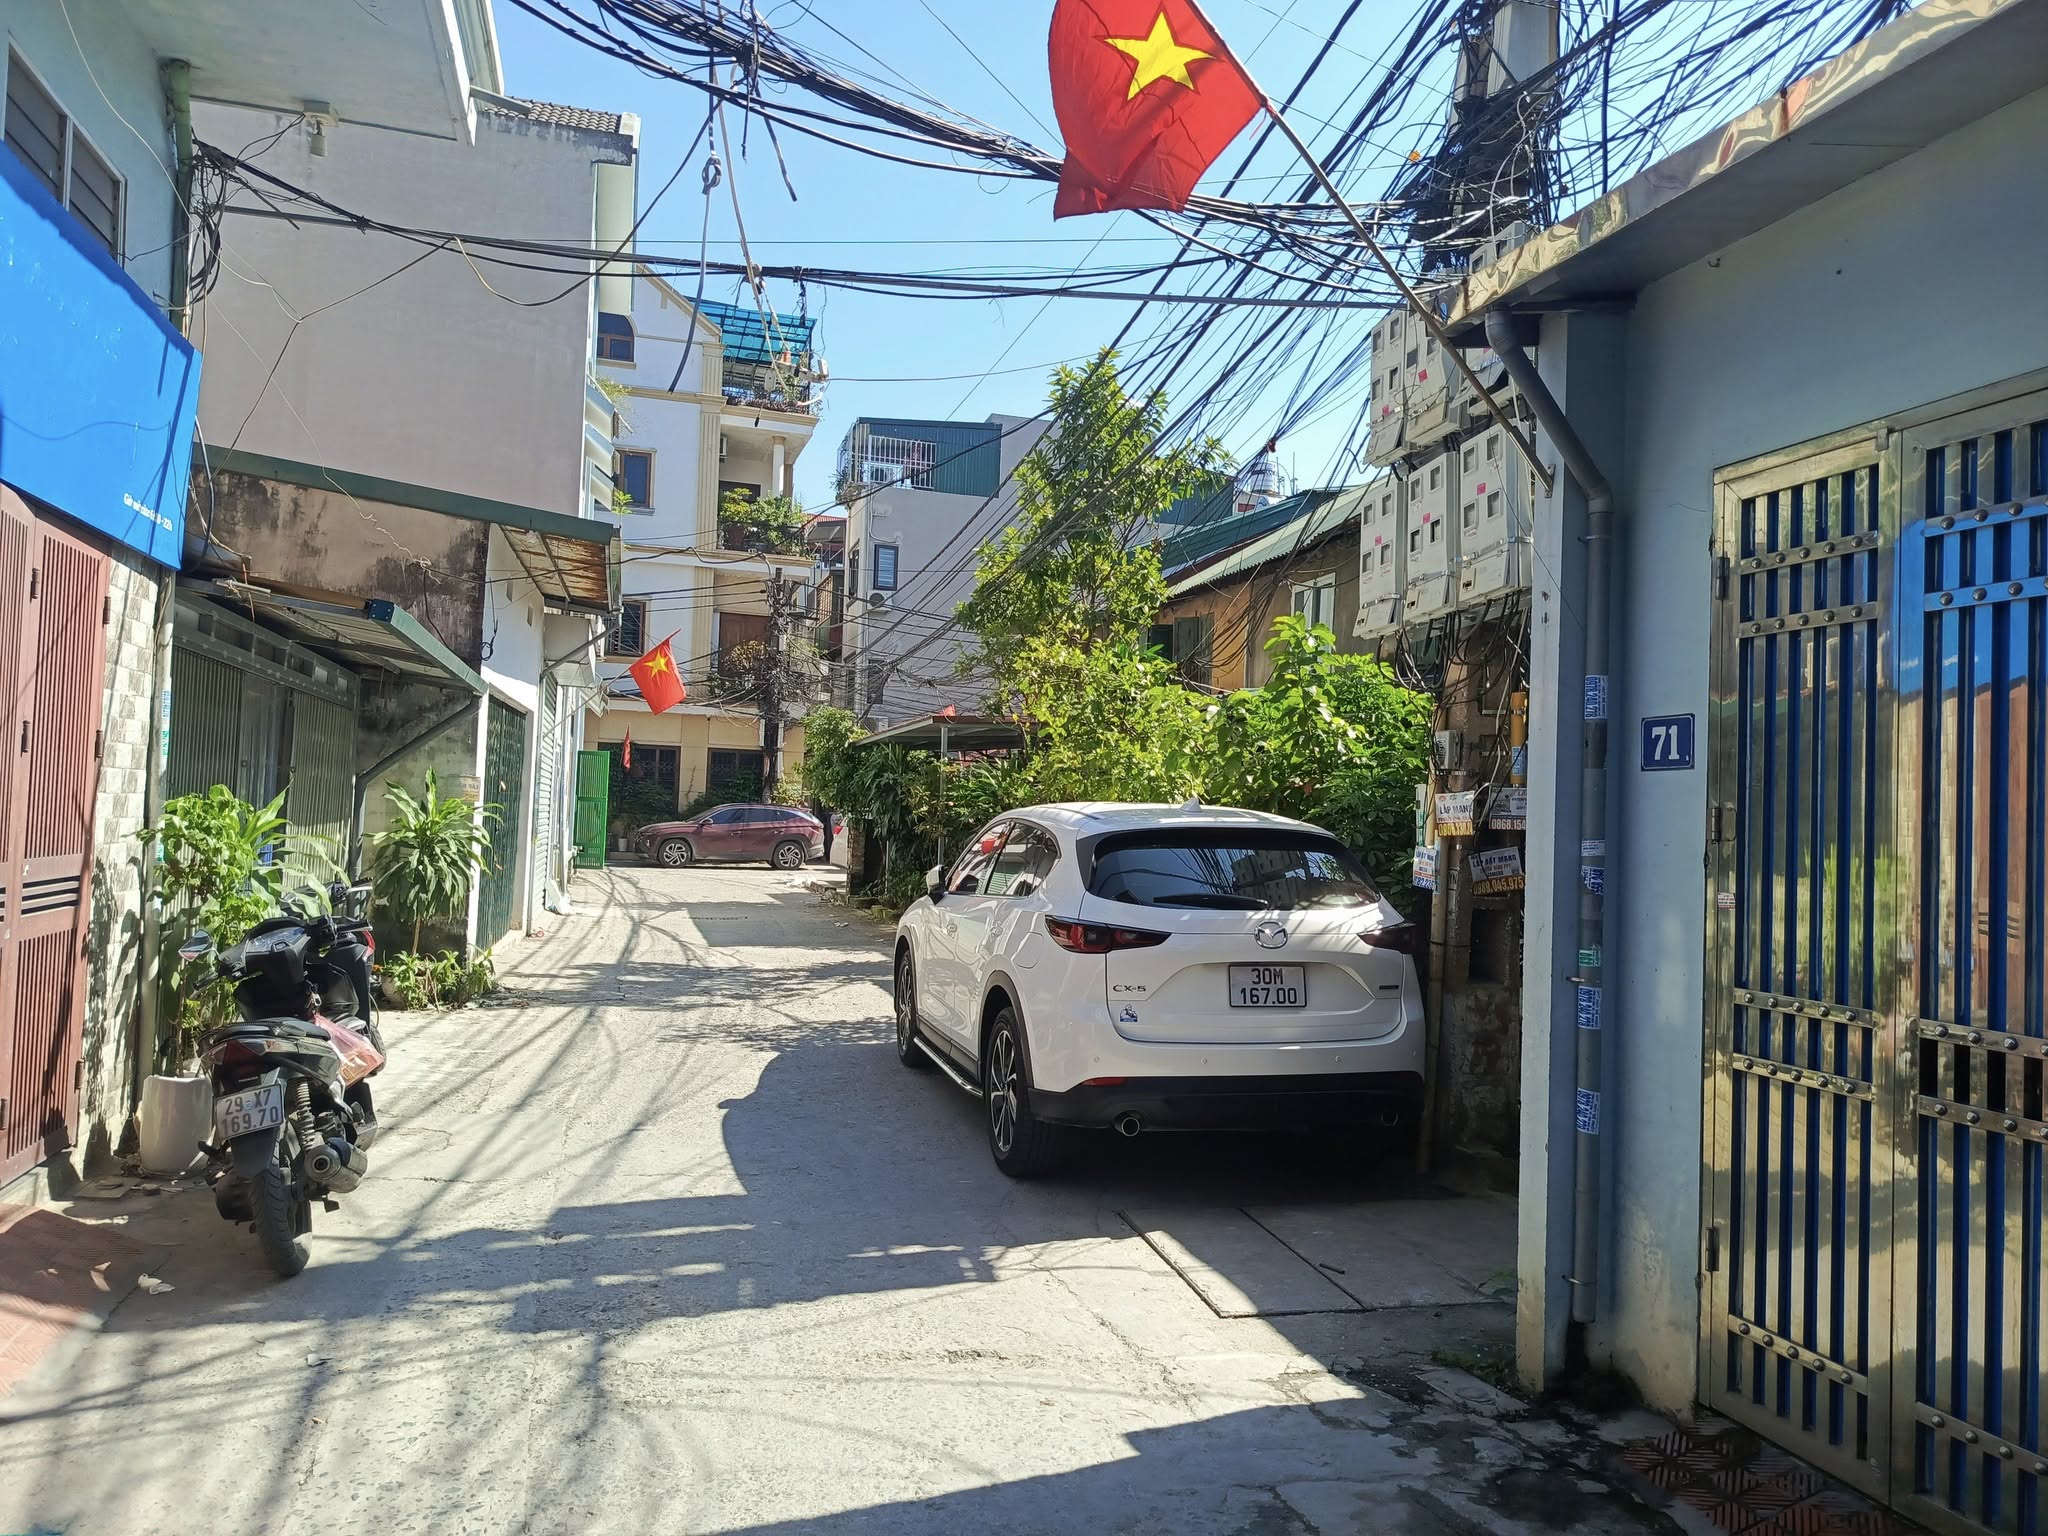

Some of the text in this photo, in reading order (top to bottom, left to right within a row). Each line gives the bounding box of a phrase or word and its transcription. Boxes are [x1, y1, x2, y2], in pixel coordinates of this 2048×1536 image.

[1651, 725, 1680, 761] 71
[1251, 967, 1284, 985] 30M
[1112, 984, 1147, 993] CX-5
[1240, 987, 1298, 1005] 167.00
[221, 1105, 279, 1136] 169.70
